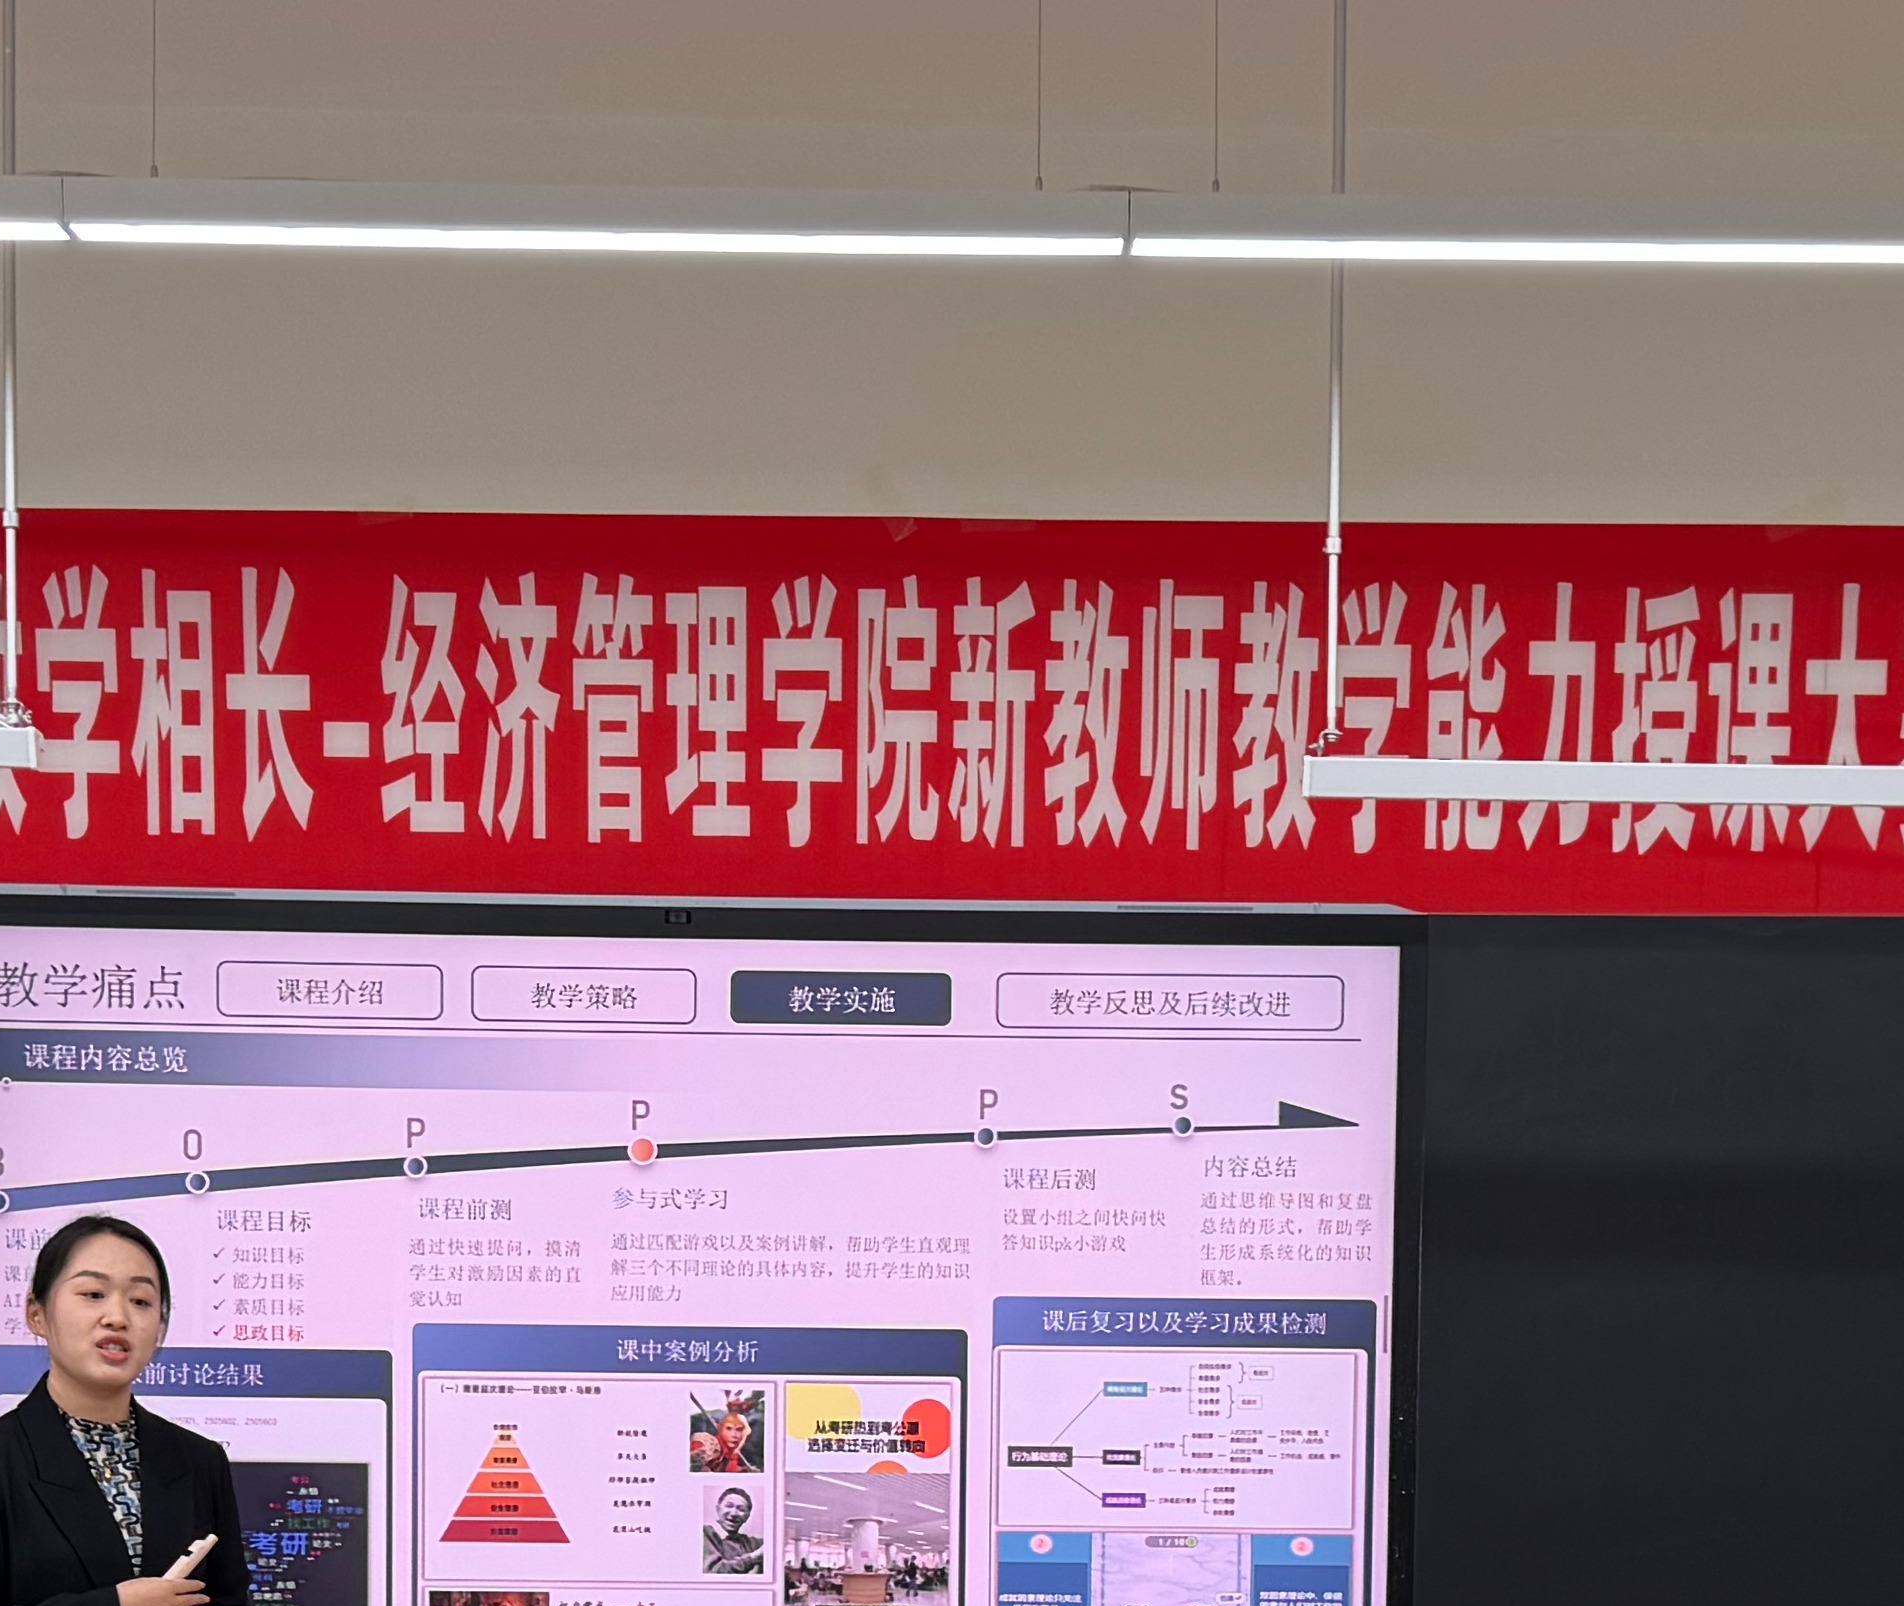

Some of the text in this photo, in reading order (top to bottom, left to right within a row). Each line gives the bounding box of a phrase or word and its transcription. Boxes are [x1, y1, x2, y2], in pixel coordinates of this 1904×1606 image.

[276, 978, 384, 1007] 课程介绍
[530, 982, 638, 1012] 教学策略
[788, 986, 896, 1015] 教学实施
[1049, 988, 1292, 1018] 教学反思及后续改进
[23, 1042, 188, 1074] 课程内容总览
[979, 1089, 998, 1120] P
[1170, 1083, 1189, 1110] S
[631, 1100, 650, 1132] P
[184, 1129, 202, 1160] O
[407, 1117, 425, 1149] P
[1204, 1155, 1297, 1178] 内容总结
[1003, 1167, 1097, 1191] 课程后测
[418, 1197, 512, 1221] 课程前测
[612, 1188, 729, 1210] 参与式学习
[1200, 1192, 1372, 1211] 通过思维导图和复盘
[216, 1209, 311, 1233] 课程目标
[1003, 1208, 1166, 1227] 设置小组之间快问快
[233, 1247, 304, 1265] 知识目标
[1200, 1243, 1372, 1262] 生形成系统化的知识
[233, 1272, 304, 1290] 能力目标
[610, 1284, 681, 1302] 应用能力
[233, 1298, 304, 1316] 素质目标
[233, 1324, 304, 1342] 思政目标
[1042, 1309, 1328, 1336] 课后复习以及学习成果检测
[616, 1339, 760, 1364] 课中案例分析
[249, 1532, 309, 1556] 考研
